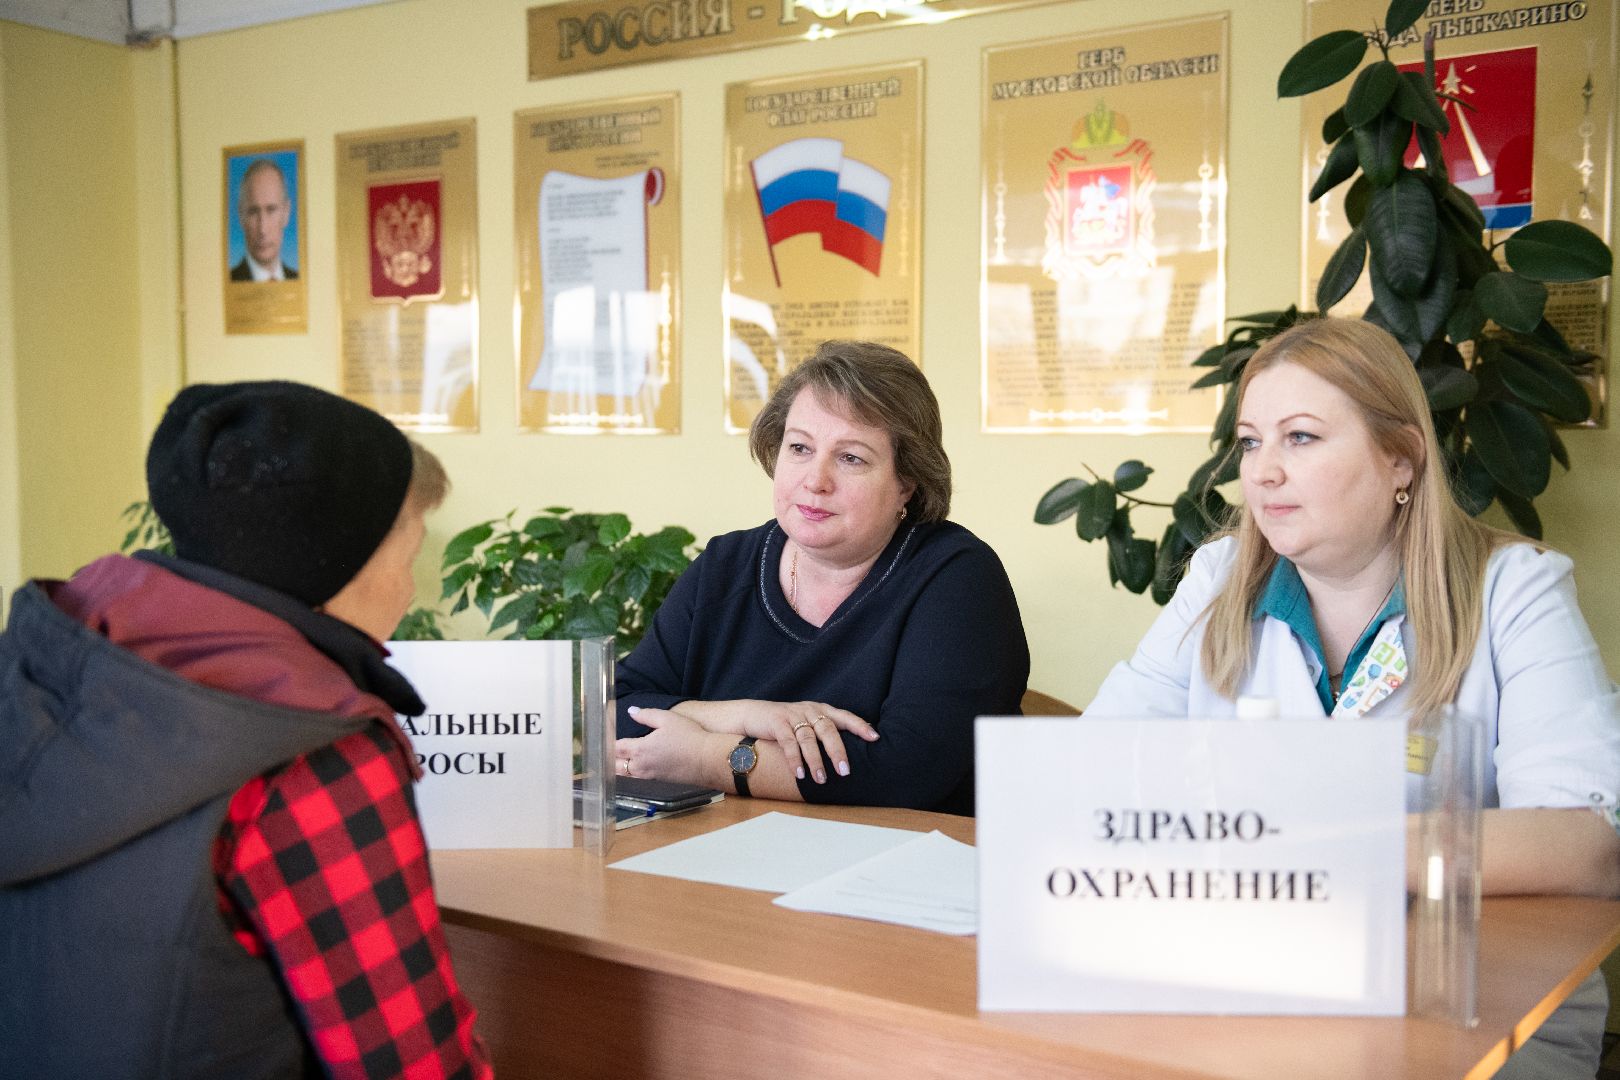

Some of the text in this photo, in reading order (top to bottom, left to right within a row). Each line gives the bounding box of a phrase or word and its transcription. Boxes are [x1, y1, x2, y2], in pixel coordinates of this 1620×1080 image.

[557, 0, 734, 61] РОССИЯ
[1428, 1, 1588, 41] ЛЫТКАРИНО
[992, 53, 1220, 100] МОСКОВСКОЙ ОБЛАСТИ
[1077, 47, 1126, 70] ГЕРБ
[400, 713, 543, 737] АЛЬНЫЕ
[415, 751, 508, 776] РОСЫ
[1093, 808, 1281, 845] ЗДРАВО-
[1046, 866, 1331, 902] ОХРАНЕНИЕ
